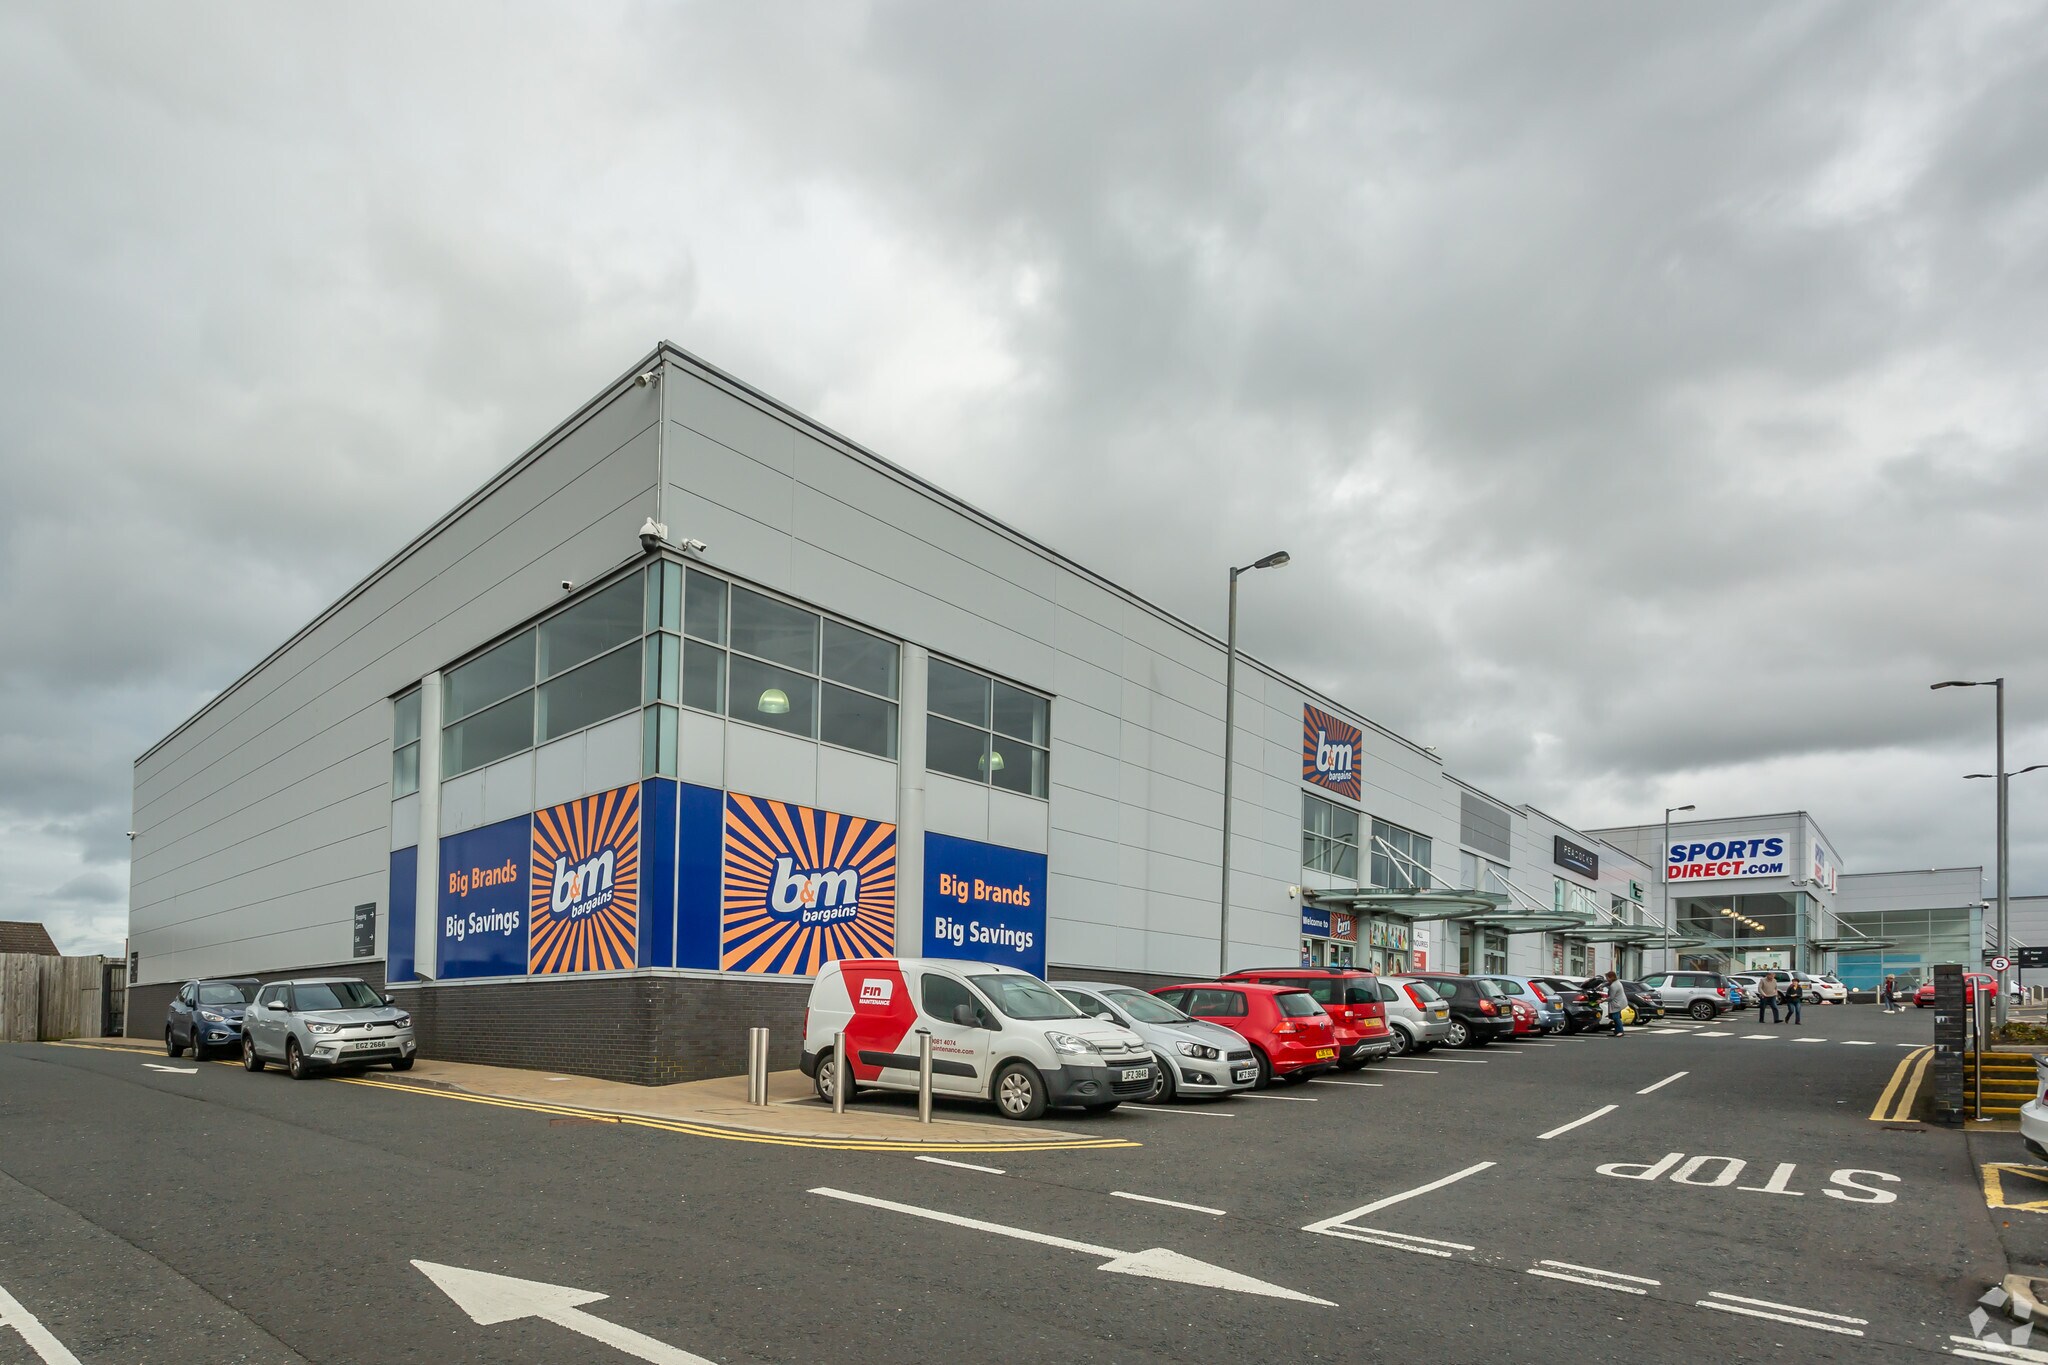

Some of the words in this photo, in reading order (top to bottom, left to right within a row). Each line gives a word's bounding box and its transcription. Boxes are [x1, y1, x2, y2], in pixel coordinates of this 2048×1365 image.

[1329, 771, 1352, 782] bargains
[1668, 837, 1784, 863] SPORTS
[449, 870, 469, 897] Big
[471, 858, 517, 890] Brands
[552, 849, 614, 913] b&m
[1668, 861, 1783, 879] DIRECT.COM
[771, 857, 858, 913] b&m
[939, 873, 968, 904] Big
[974, 879, 1031, 907] Brands
[571, 889, 613, 918] bargains
[802, 905, 857, 923] bargains
[446, 913, 465, 942] Big
[468, 907, 520, 936] Savings
[935, 917, 965, 947] Big
[969, 921, 1034, 952] Savings
[1302, 916, 1323, 928] Welcome
[1323, 920, 1329, 928] to
[1995, 959, 2005, 968] 5
[859, 998, 890, 1006] MAINTENANCE
[863, 986, 882, 997] FIN
[355, 1042, 369, 1050] EGZ
[370, 1040, 386, 1049] 2666
[1595, 1152, 1902, 1204] STOP
